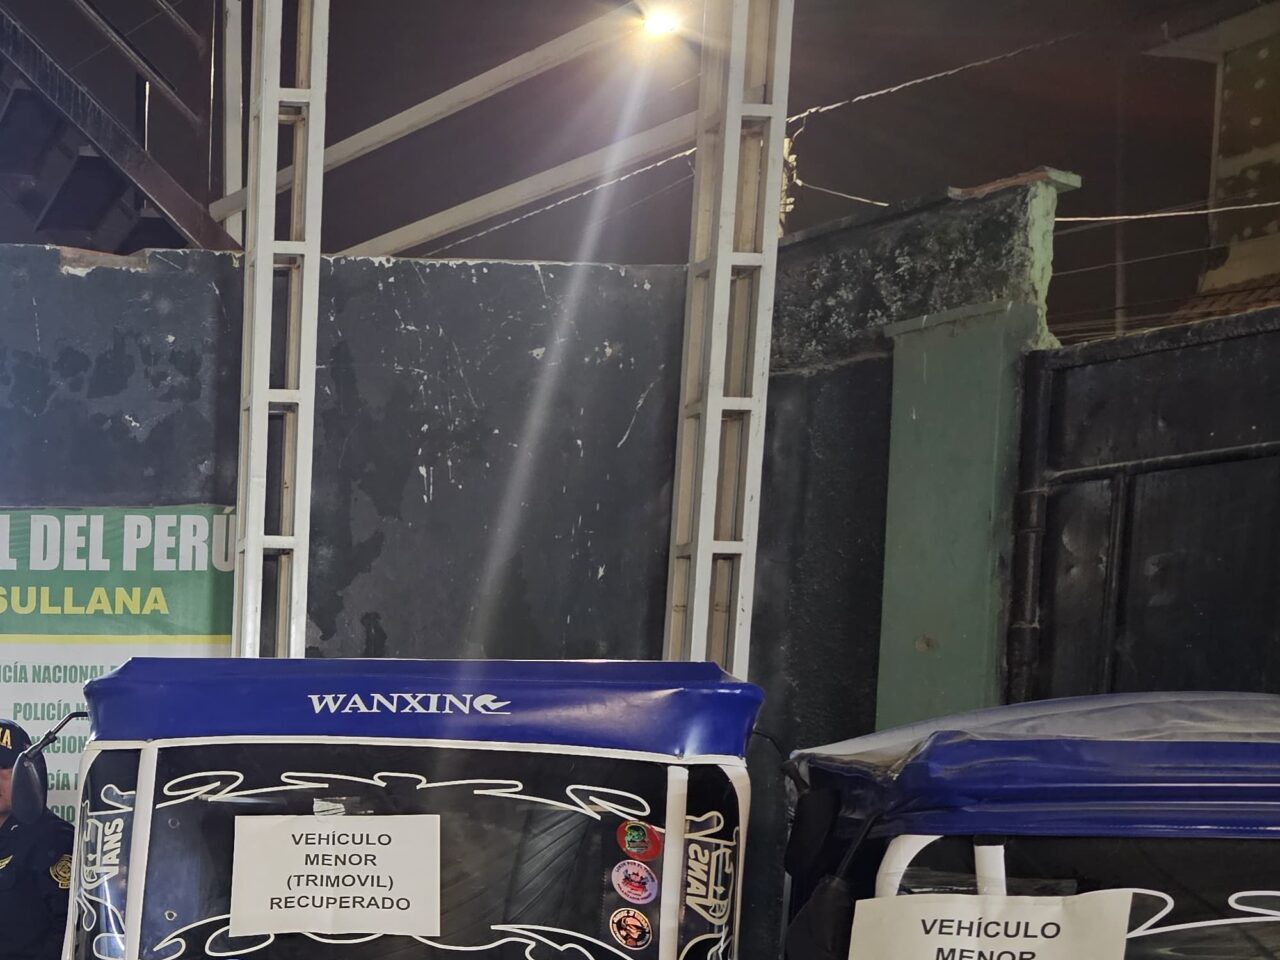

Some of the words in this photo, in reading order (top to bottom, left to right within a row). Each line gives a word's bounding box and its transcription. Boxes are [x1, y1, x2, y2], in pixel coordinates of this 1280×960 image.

[29, 514, 110, 571] DEL
[123, 506, 236, 572] PERÚ
[291, 830, 392, 846] VEHÍCULO
[96, 818, 125, 881] VANS
[304, 853, 377, 867] MENOR
[286, 873, 395, 891] (TRIMOVIL)
[269, 896, 411, 911] RECUPERADO
[920, 917, 1061, 939] VEHÍCULO
